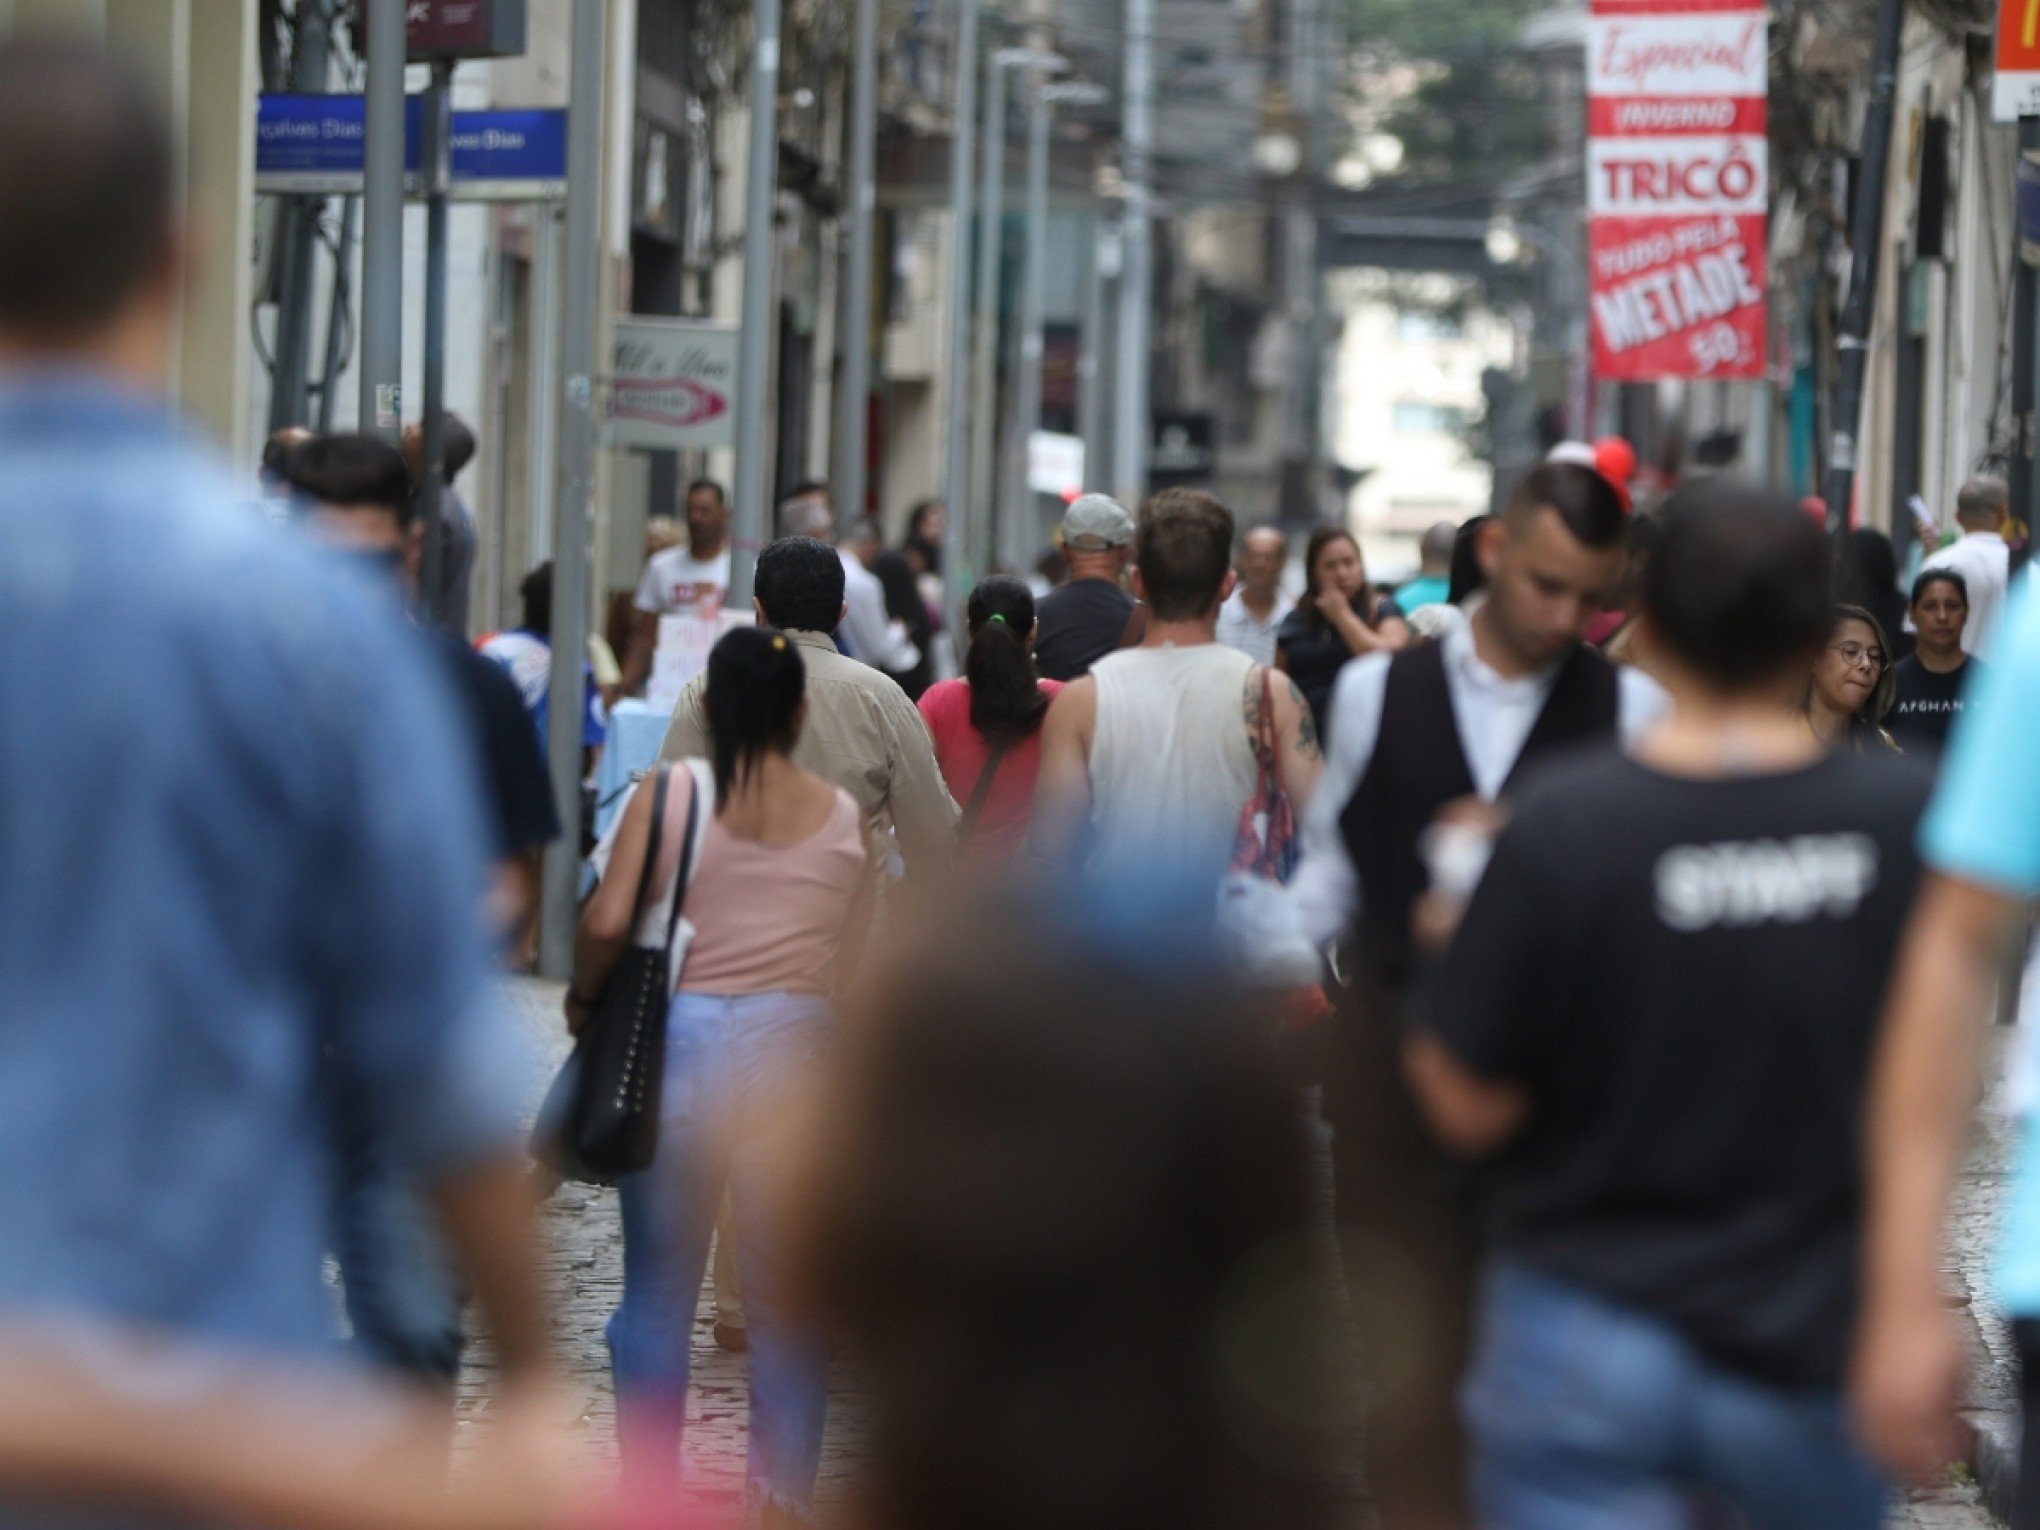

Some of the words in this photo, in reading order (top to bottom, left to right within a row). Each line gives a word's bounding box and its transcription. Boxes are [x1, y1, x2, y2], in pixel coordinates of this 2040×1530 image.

[1615, 101, 1736, 129] INVERNO
[1602, 140, 1756, 200] TRICÔ
[1599, 238, 1672, 279] TUDO
[1672, 215, 1740, 253] PELA
[1593, 243, 1762, 352] METADE
